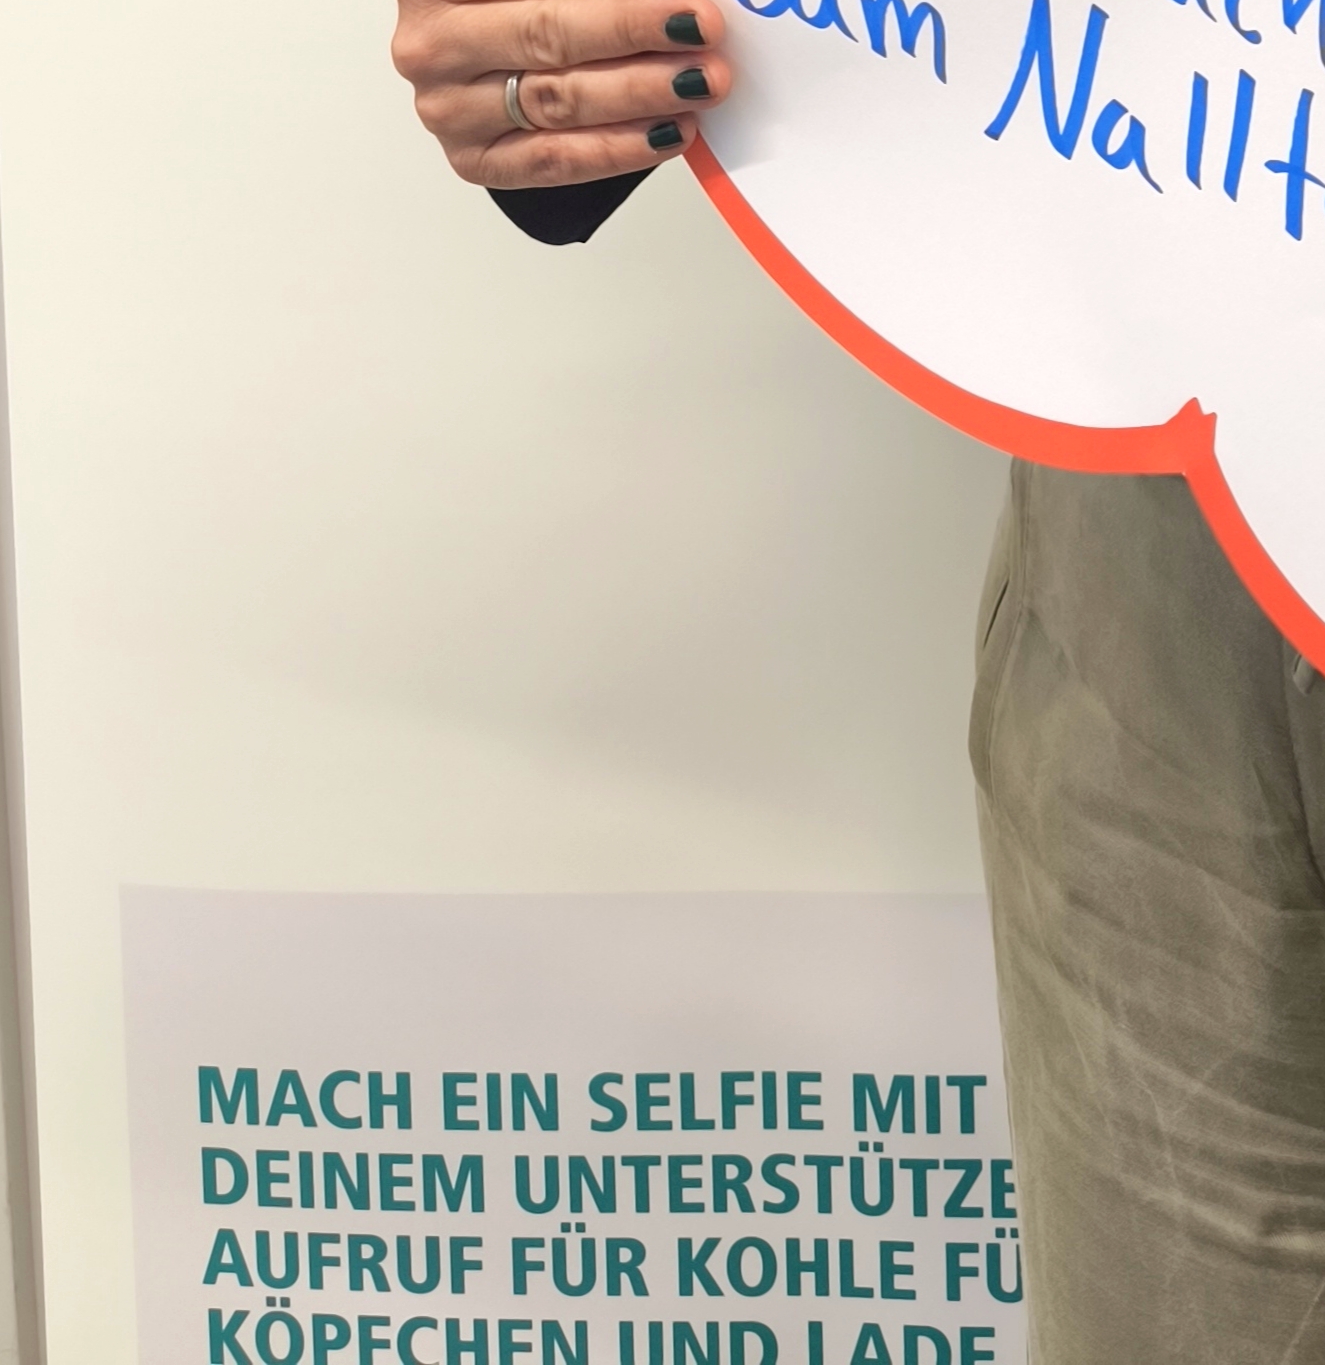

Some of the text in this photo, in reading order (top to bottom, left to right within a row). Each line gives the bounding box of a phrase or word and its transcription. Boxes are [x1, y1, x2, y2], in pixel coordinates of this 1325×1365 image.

[197, 1065, 988, 1136] MACH EIN SELFIE MIT
[200, 1140, 1018, 1219] DEINEM UNTERSTÜTZE
[202, 1227, 484, 1295] AUFRUF
[510, 1221, 650, 1297] FÜR
[676, 1236, 918, 1301] KOHLE
[206, 1295, 590, 1365] KÖPFCHEN
[617, 1320, 780, 1365] UND
